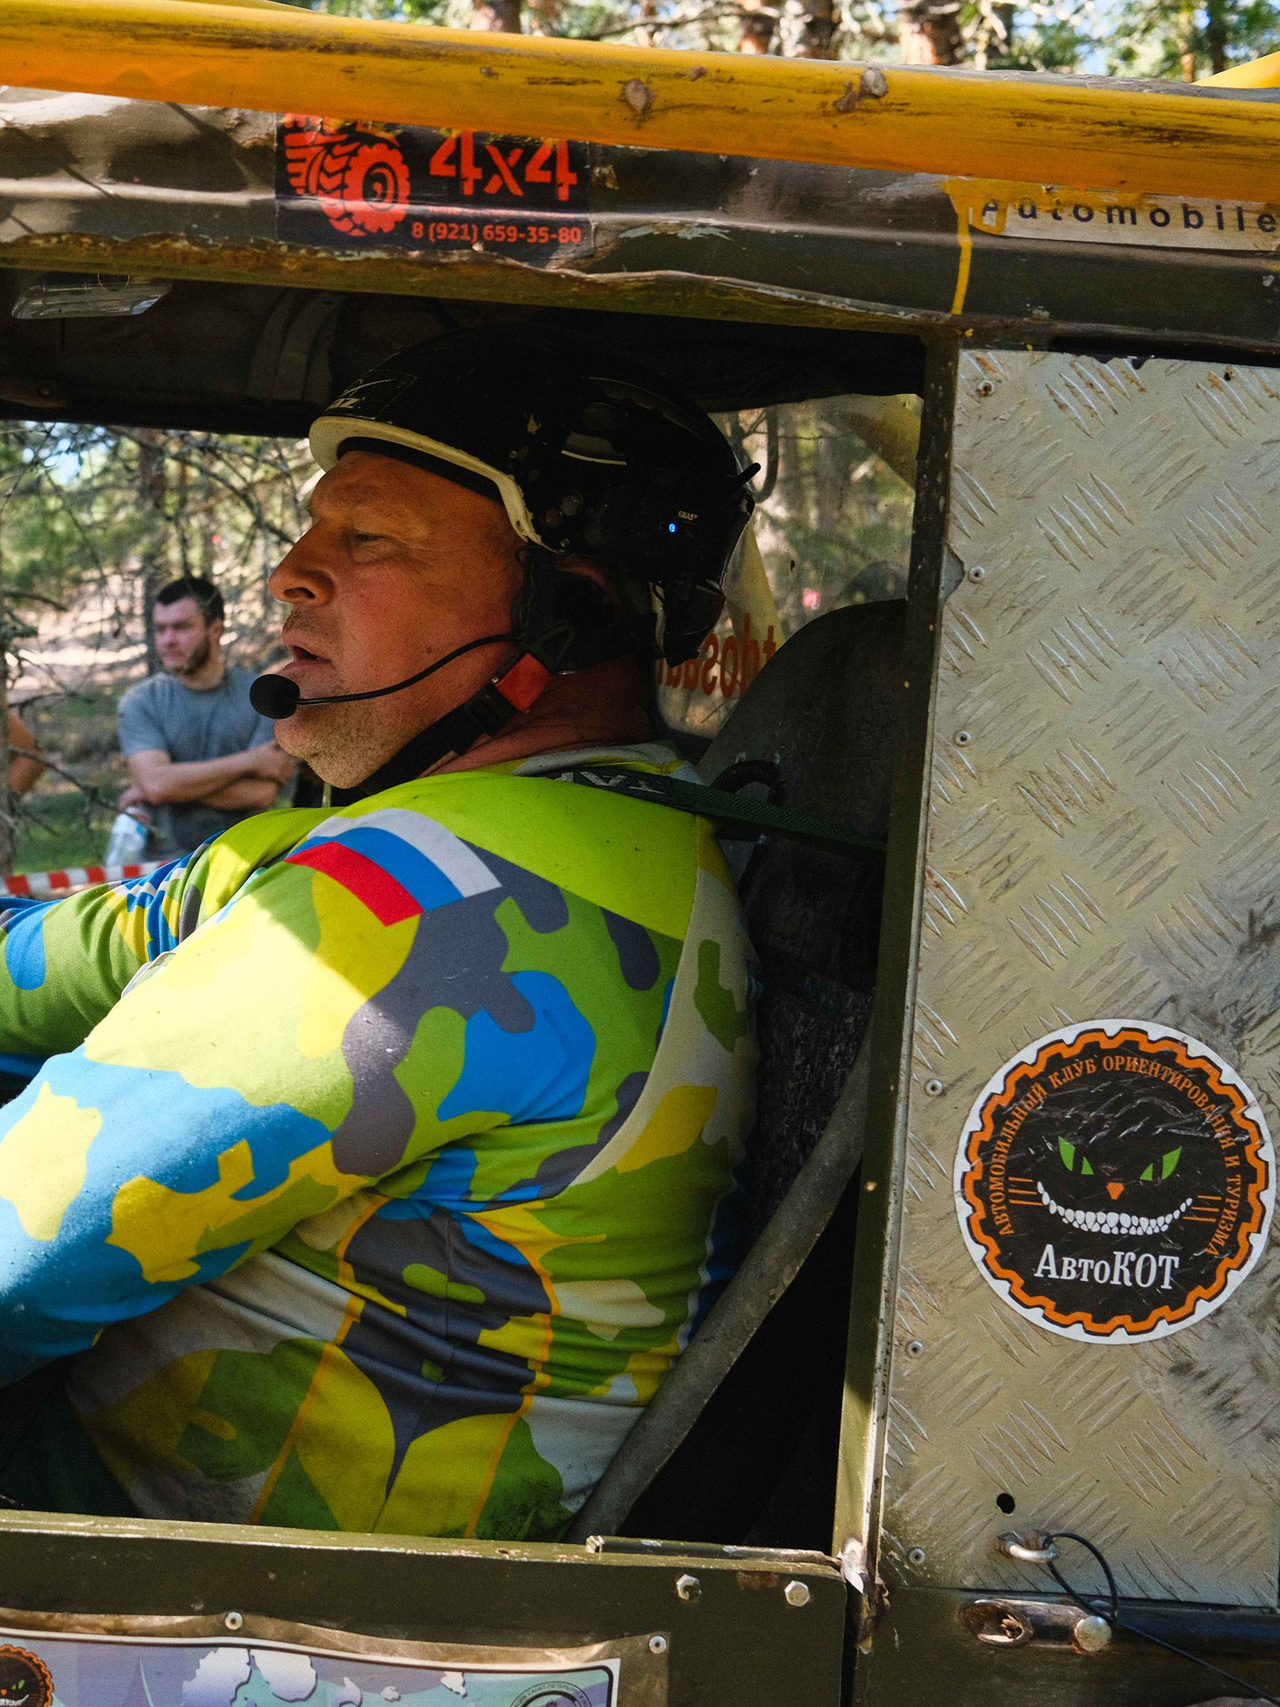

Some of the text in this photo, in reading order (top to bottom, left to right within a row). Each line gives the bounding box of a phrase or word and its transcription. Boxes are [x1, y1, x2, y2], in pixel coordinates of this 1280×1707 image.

[428, 129, 578, 201] 4x4
[411, 221, 582, 244] 8 (921) 659-35-80
[989, 1055, 1243, 1257] АВТОМОБИЛЬНЫЙ КЛУБ ОРИЕНТИРОВАНИЯ И ТУРИЗМА
